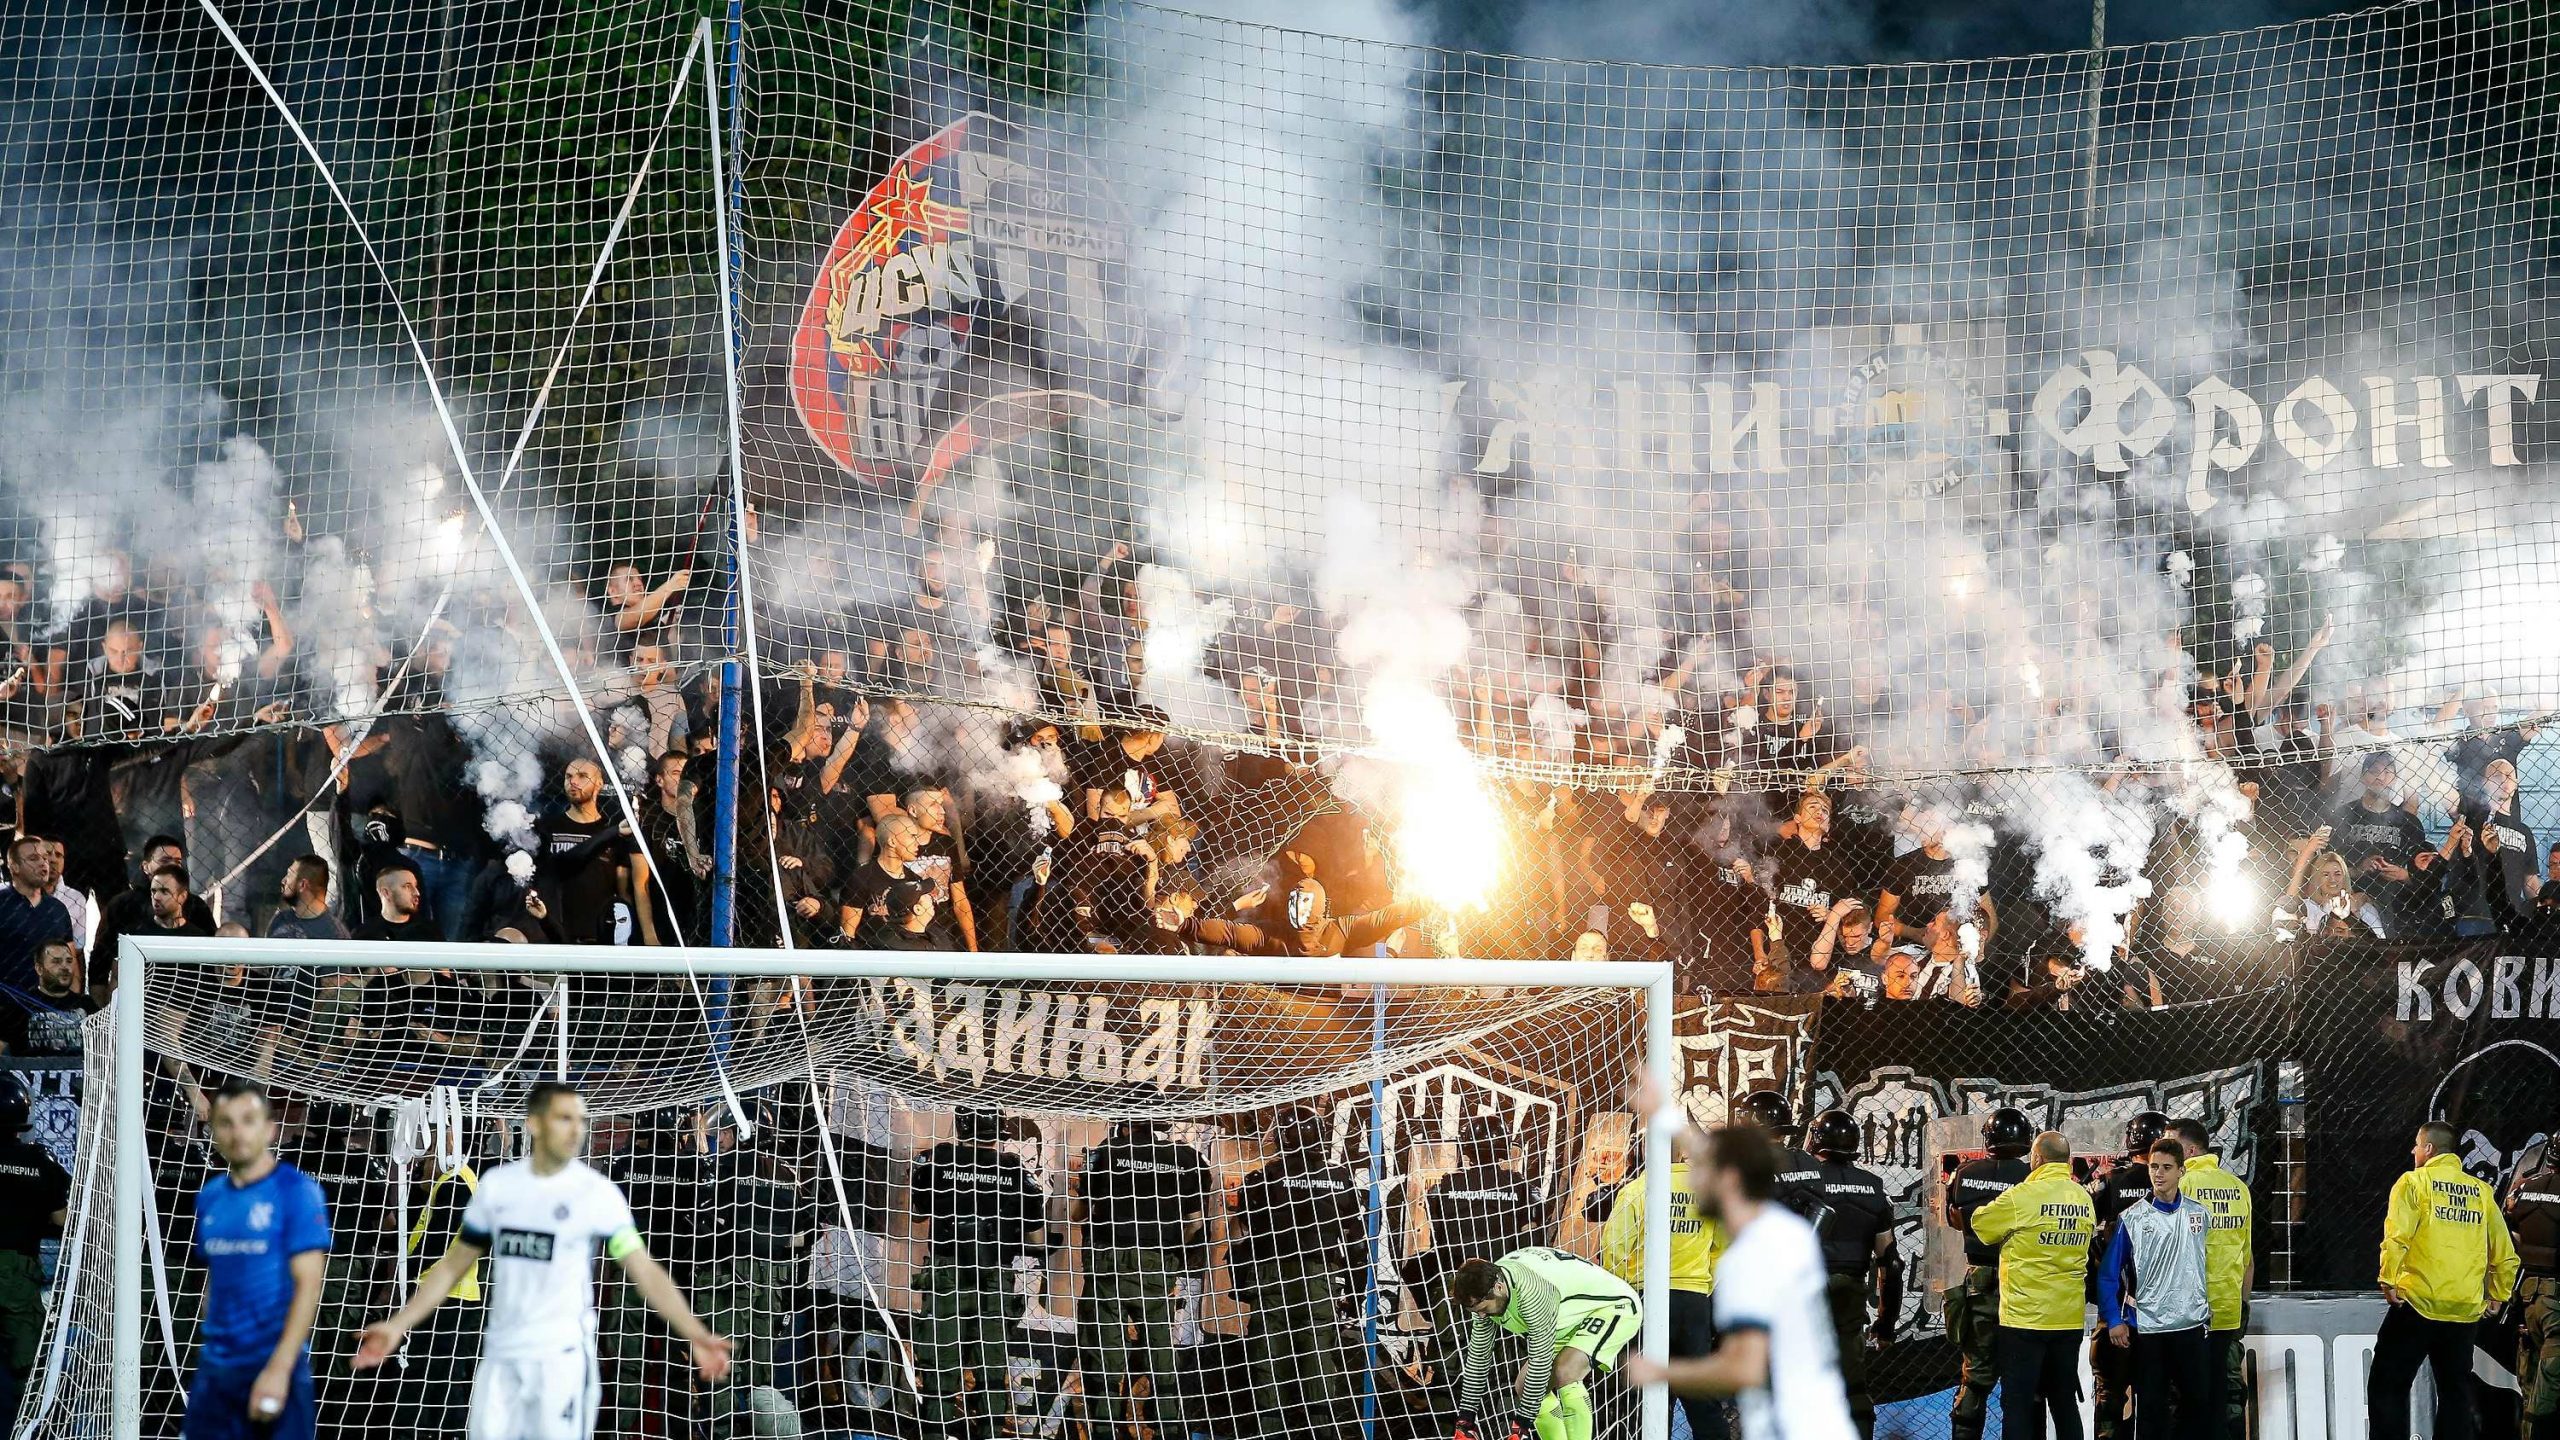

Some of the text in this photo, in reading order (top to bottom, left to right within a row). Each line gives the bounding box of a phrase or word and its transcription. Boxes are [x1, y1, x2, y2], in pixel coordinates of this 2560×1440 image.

[1440, 379, 1789, 474] ЖНИ
[0, 1164, 40, 1178] АРМЕРИЈА
[942, 1170, 1013, 1186] ЖАНДАРМЕРИЈА
[1282, 1179, 1345, 1191] ЖАНДАРМЕРИЈА
[1825, 1183, 1876, 1195] НДАРМЕРИЈА
[1961, 1178, 2014, 1192] ЖАНДАРМЕРИ
[2432, 1180, 2480, 1198] PETKOVIĆ
[1448, 1190, 1519, 1202] ЖАНДАРМЕРИЈА
[2197, 1186, 2241, 1201] PETKOVIĆ
[2212, 1201, 2229, 1214] TIM
[2448, 1194, 2467, 1208] TIM
[2040, 1203, 2090, 1218] PETKOVIĆ
[2435, 1206, 2484, 1225] SECURITY
[1670, 1219, 1705, 1233] URITY
[2058, 1218, 2077, 1230] TIM
[2208, 1215, 2246, 1229] CURITY
[501, 1233, 550, 1260] mts
[561, 1400, 575, 1422] 4
